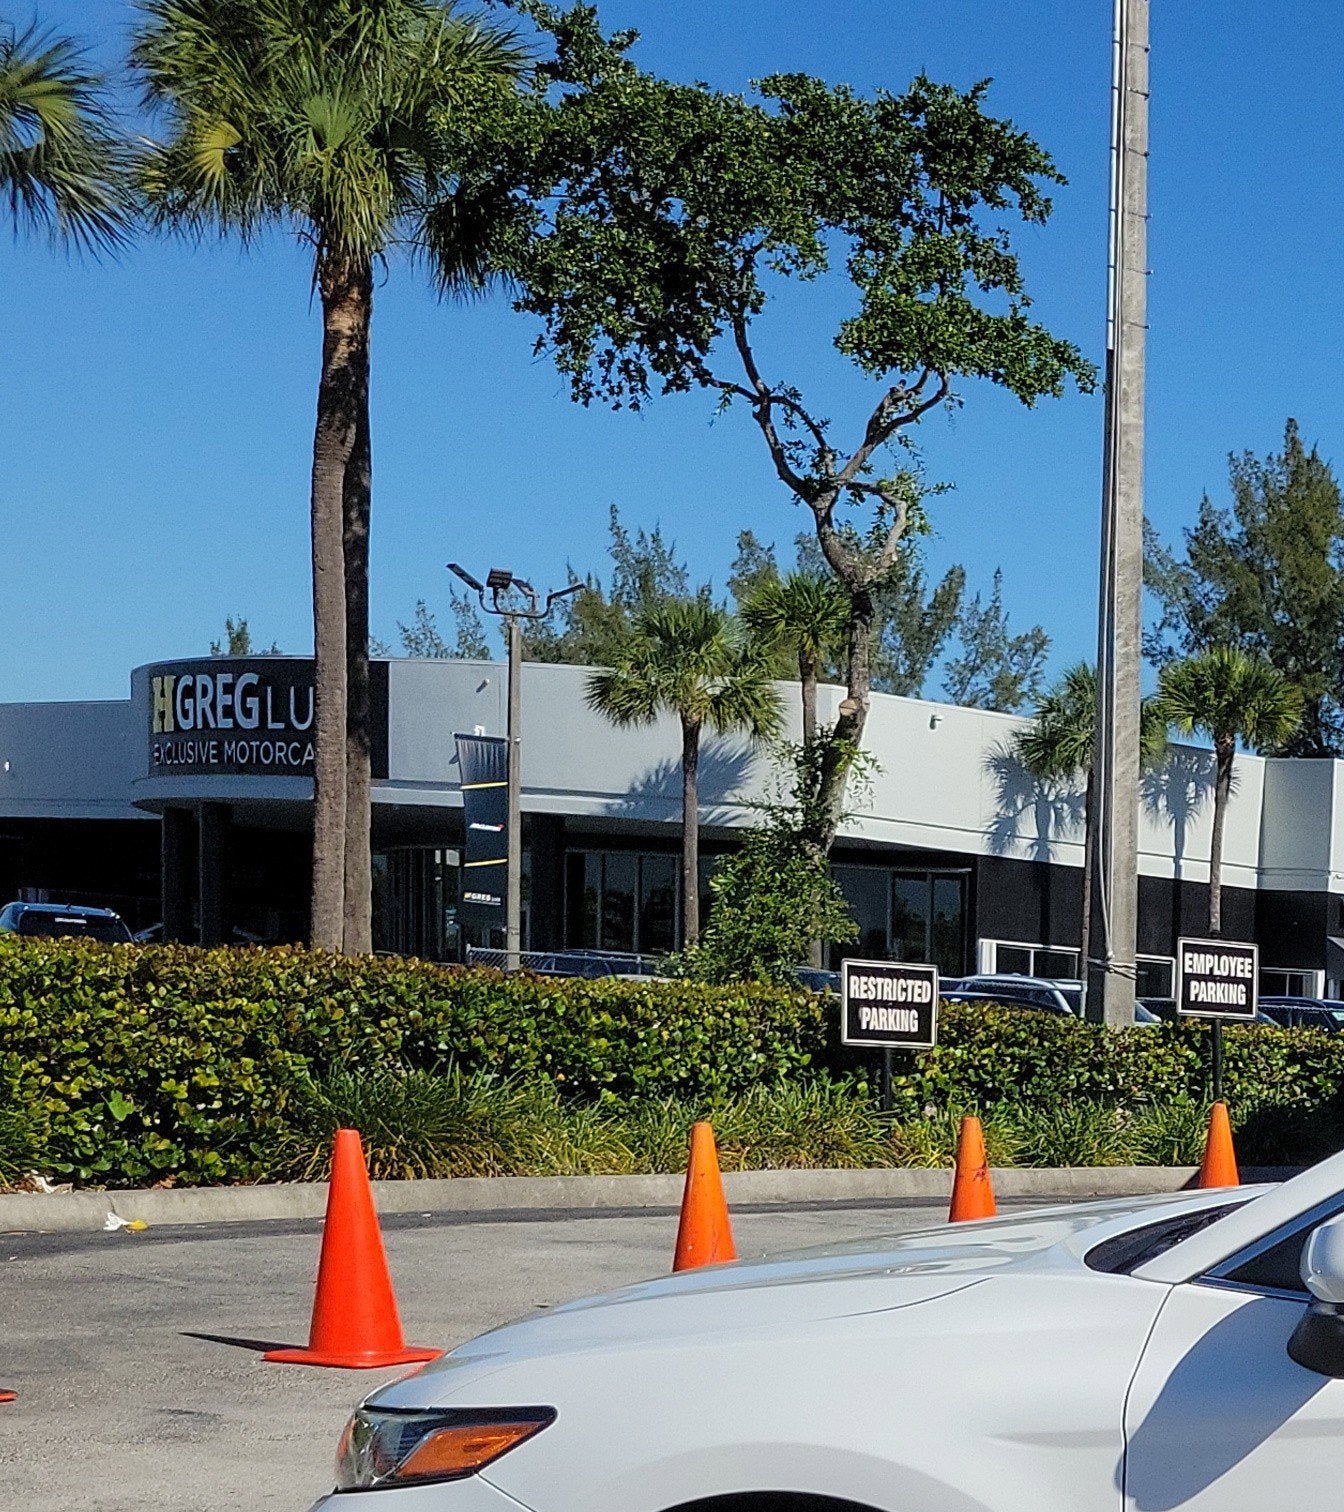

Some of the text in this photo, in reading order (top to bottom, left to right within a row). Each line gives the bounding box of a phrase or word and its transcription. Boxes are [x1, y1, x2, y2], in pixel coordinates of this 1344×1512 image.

[152, 673, 260, 734] HGREG
[153, 740, 219, 766] EXCLUSIVE
[1184, 952, 1253, 978] EMPLOYEE
[849, 975, 932, 1003] RESTRICTED
[1189, 980, 1247, 1006] PARKING
[860, 1007, 919, 1033] PARKING
